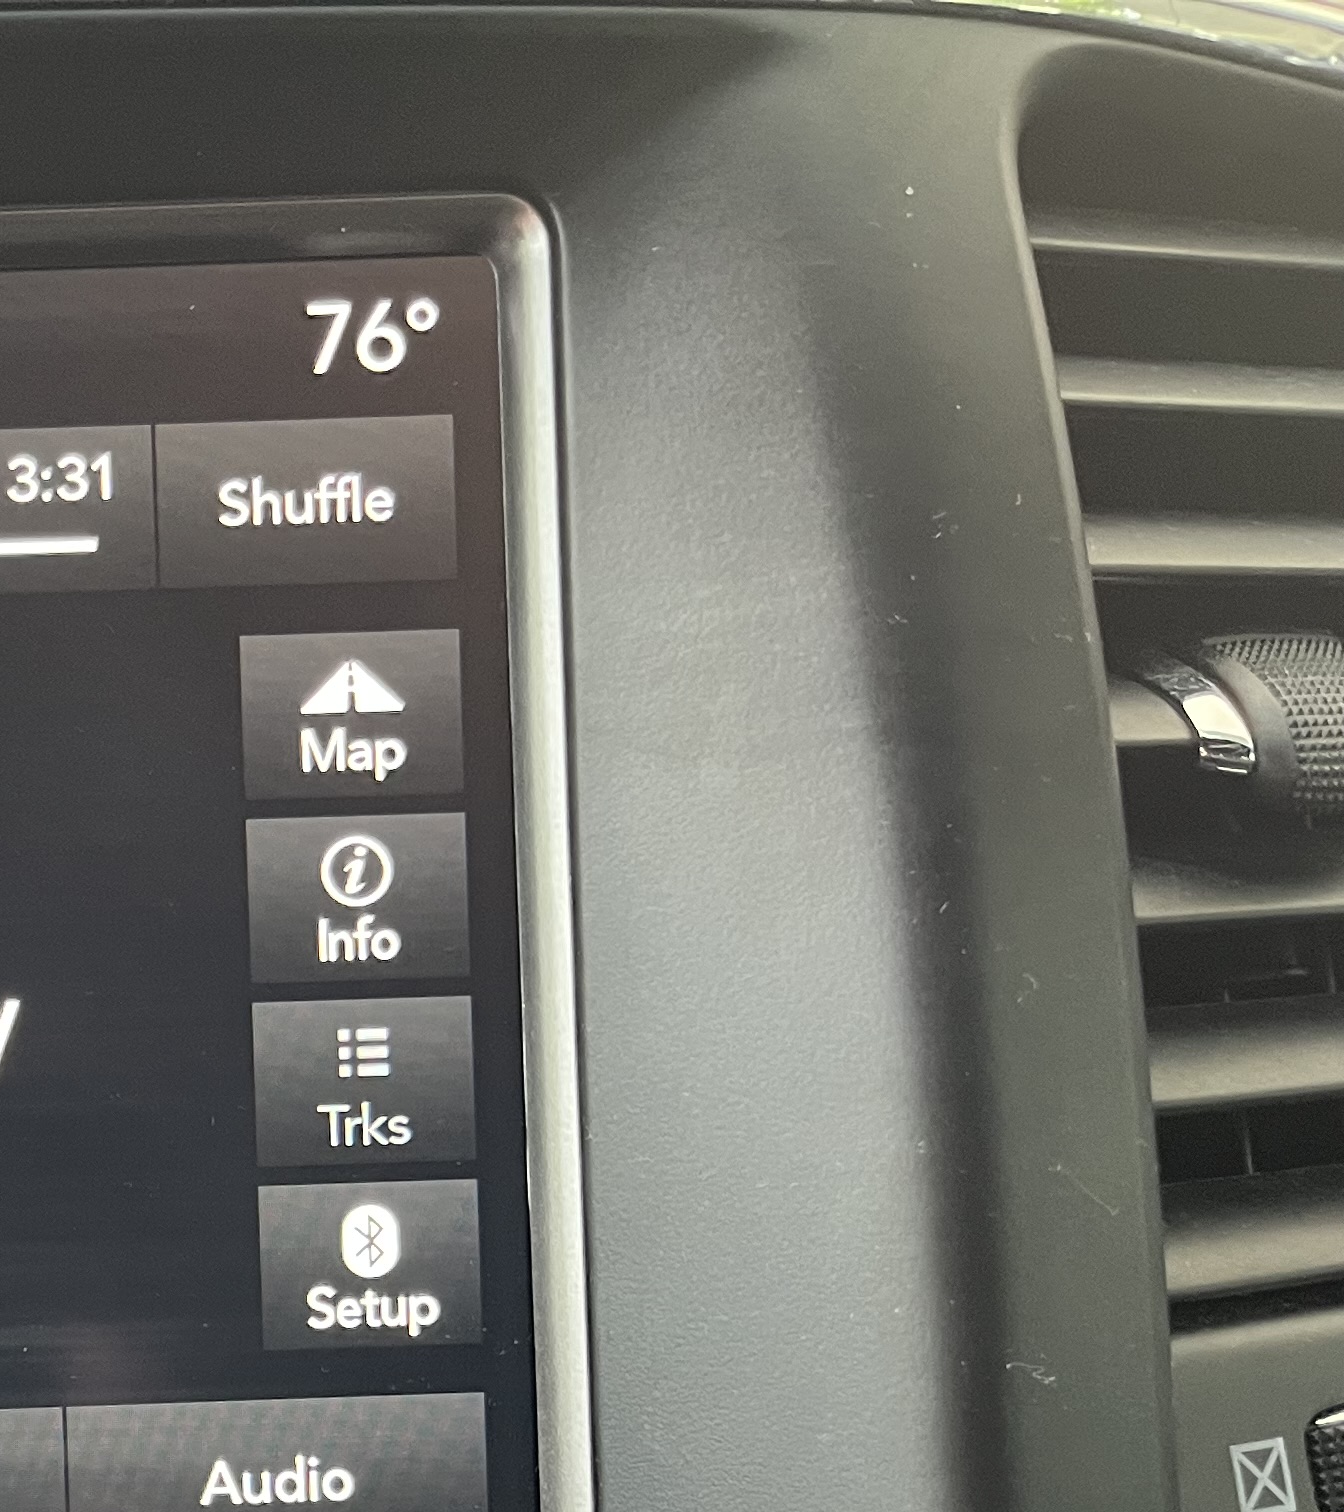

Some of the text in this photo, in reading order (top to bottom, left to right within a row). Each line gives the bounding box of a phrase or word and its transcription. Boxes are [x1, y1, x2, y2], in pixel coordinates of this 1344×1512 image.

[306, 296, 440, 375] 76°
[6, 451, 112, 503] 3:31
[218, 471, 396, 527] Shuffle
[300, 726, 408, 782] Map
[317, 912, 402, 963] Info
[316, 1100, 412, 1147] Trks
[306, 1282, 441, 1337] Setup
[199, 1452, 355, 1506] Audio
